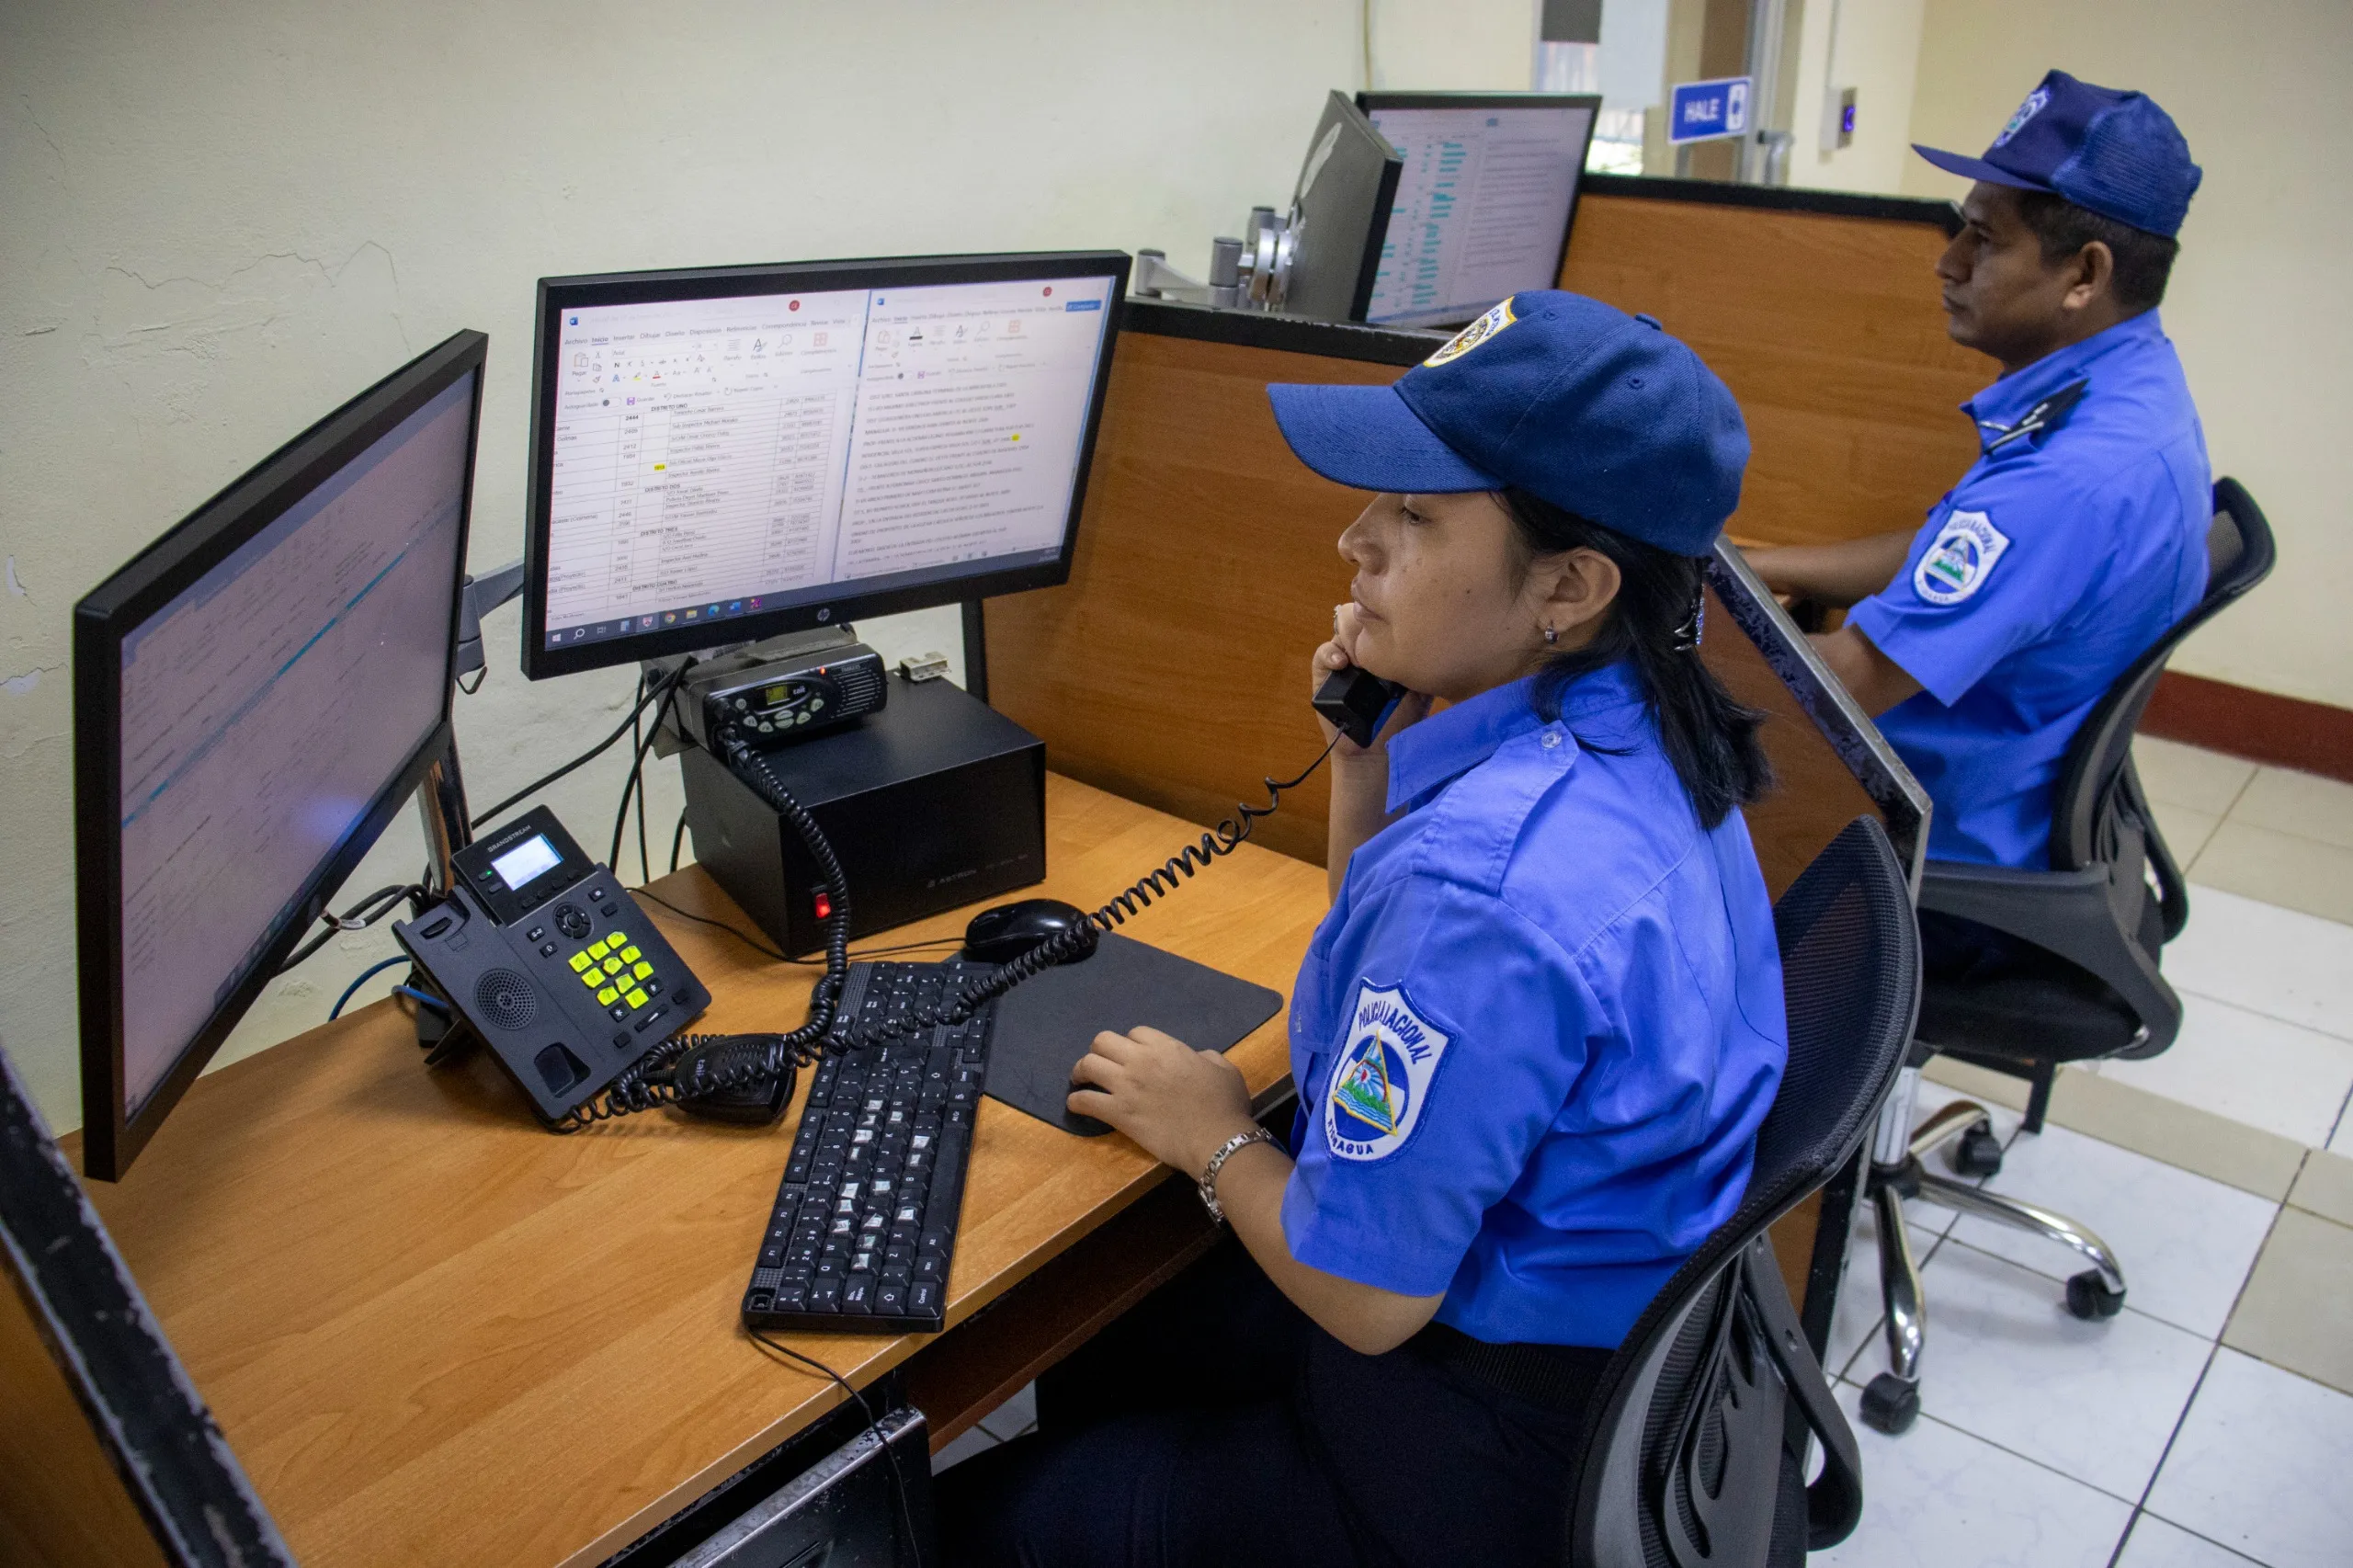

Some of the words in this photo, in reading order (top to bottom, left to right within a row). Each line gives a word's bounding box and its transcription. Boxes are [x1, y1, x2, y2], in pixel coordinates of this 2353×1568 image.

[1684, 97, 1721, 123] HALE
[793, 685, 806, 695] tait
[487, 824, 532, 853] GRANDSTREAM
[696, 1059, 706, 1077] tait
[1327, 1118, 1374, 1155] NICRAGUA
